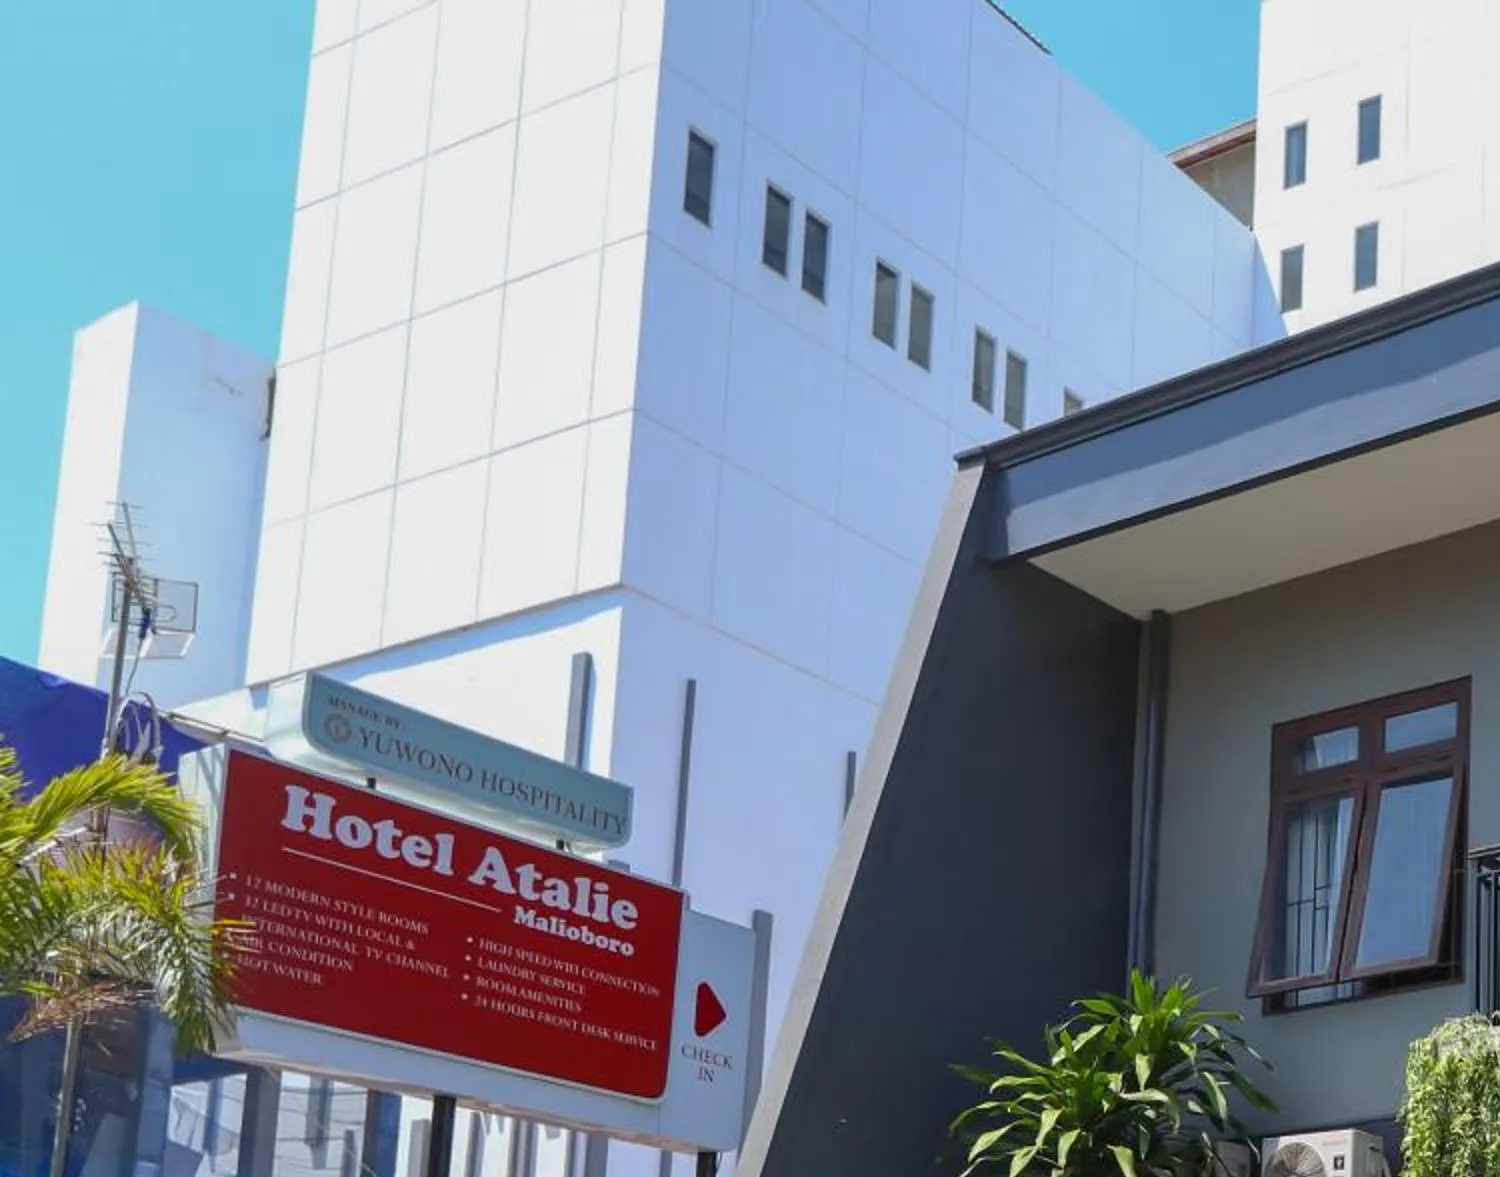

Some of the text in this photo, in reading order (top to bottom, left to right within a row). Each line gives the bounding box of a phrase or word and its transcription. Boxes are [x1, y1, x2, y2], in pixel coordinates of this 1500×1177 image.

[359, 727, 627, 836] YUWONO HOSPITALITY
[281, 785, 638, 930] Hotel Atalie
[264, 880, 330, 908] MODERN
[334, 898, 374, 920] STYLE
[379, 911, 430, 935] ROOMS
[315, 913, 353, 935] WITH
[356, 924, 401, 947] LOCAL
[405, 940, 415, 951] &
[514, 905, 635, 956] Malioboro
[237, 953, 322, 984] HOT WATER
[268, 942, 353, 972] CONDITION
[366, 945, 383, 961] TV
[385, 952, 450, 978] CHANNEL
[478, 956, 585, 995] LAUNDRY SERVICE
[479, 938, 513, 957] HIGH
[515, 948, 552, 968] SPEED
[581, 967, 660, 997] CONNECTION
[491, 998, 536, 1020] HOURS
[537, 1011, 578, 1031] FRONT
[581, 1022, 610, 1039] DESK
[613, 1030, 656, 1050] SERVICE
[681, 1043, 733, 1071] CHECK
[698, 1065, 714, 1083] IN
